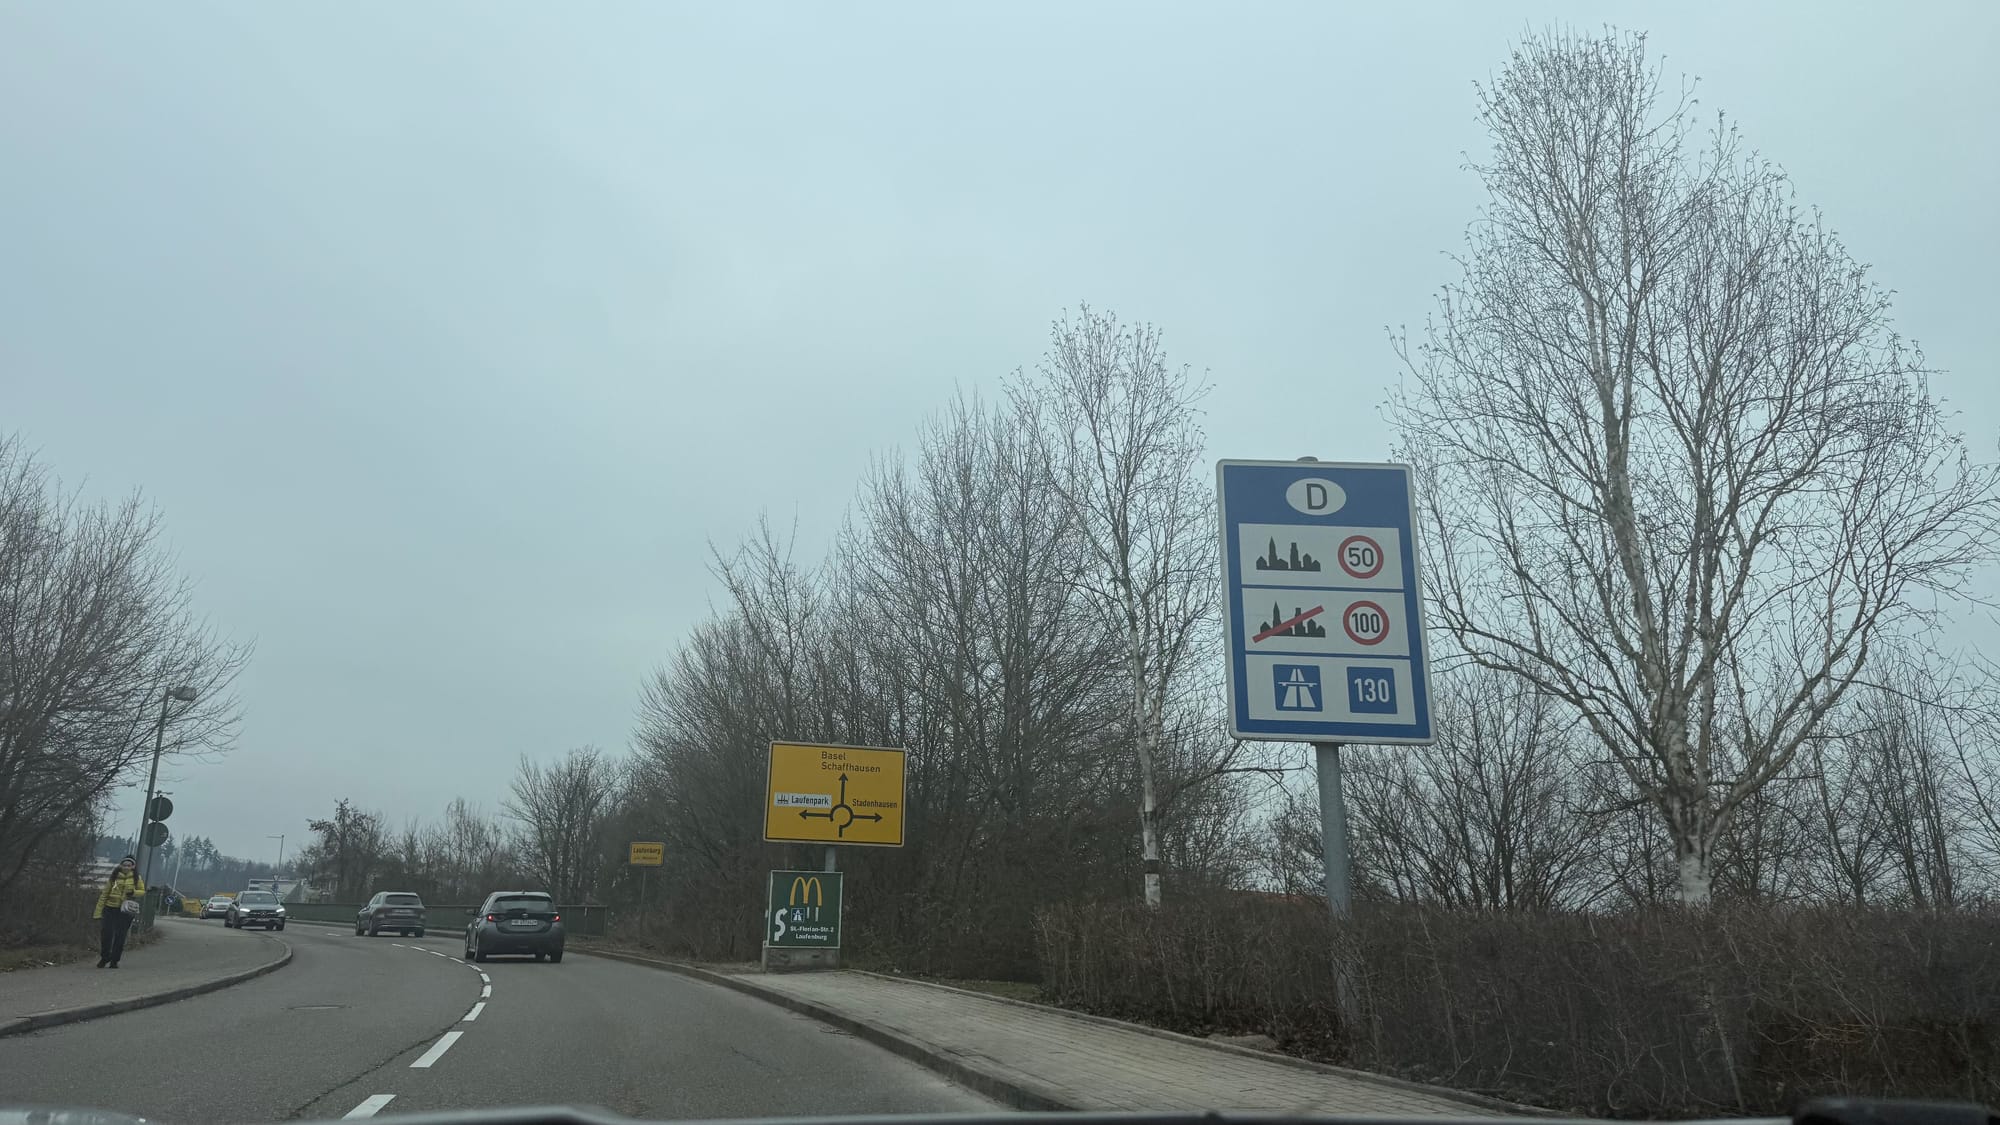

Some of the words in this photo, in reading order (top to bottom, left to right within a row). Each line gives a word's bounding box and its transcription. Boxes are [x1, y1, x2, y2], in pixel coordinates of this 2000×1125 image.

[1306, 483, 1328, 510] D
[1348, 547, 1374, 567] 50
[1351, 612, 1380, 634] 100
[1354, 677, 1390, 703] 130
[821, 751, 846, 760] Basel
[821, 761, 881, 773] Schaffhausen
[791, 795, 829, 807] Laufenpark
[852, 798, 898, 809] Stadenhausen
[795, 933, 828, 941] Laufenburg
